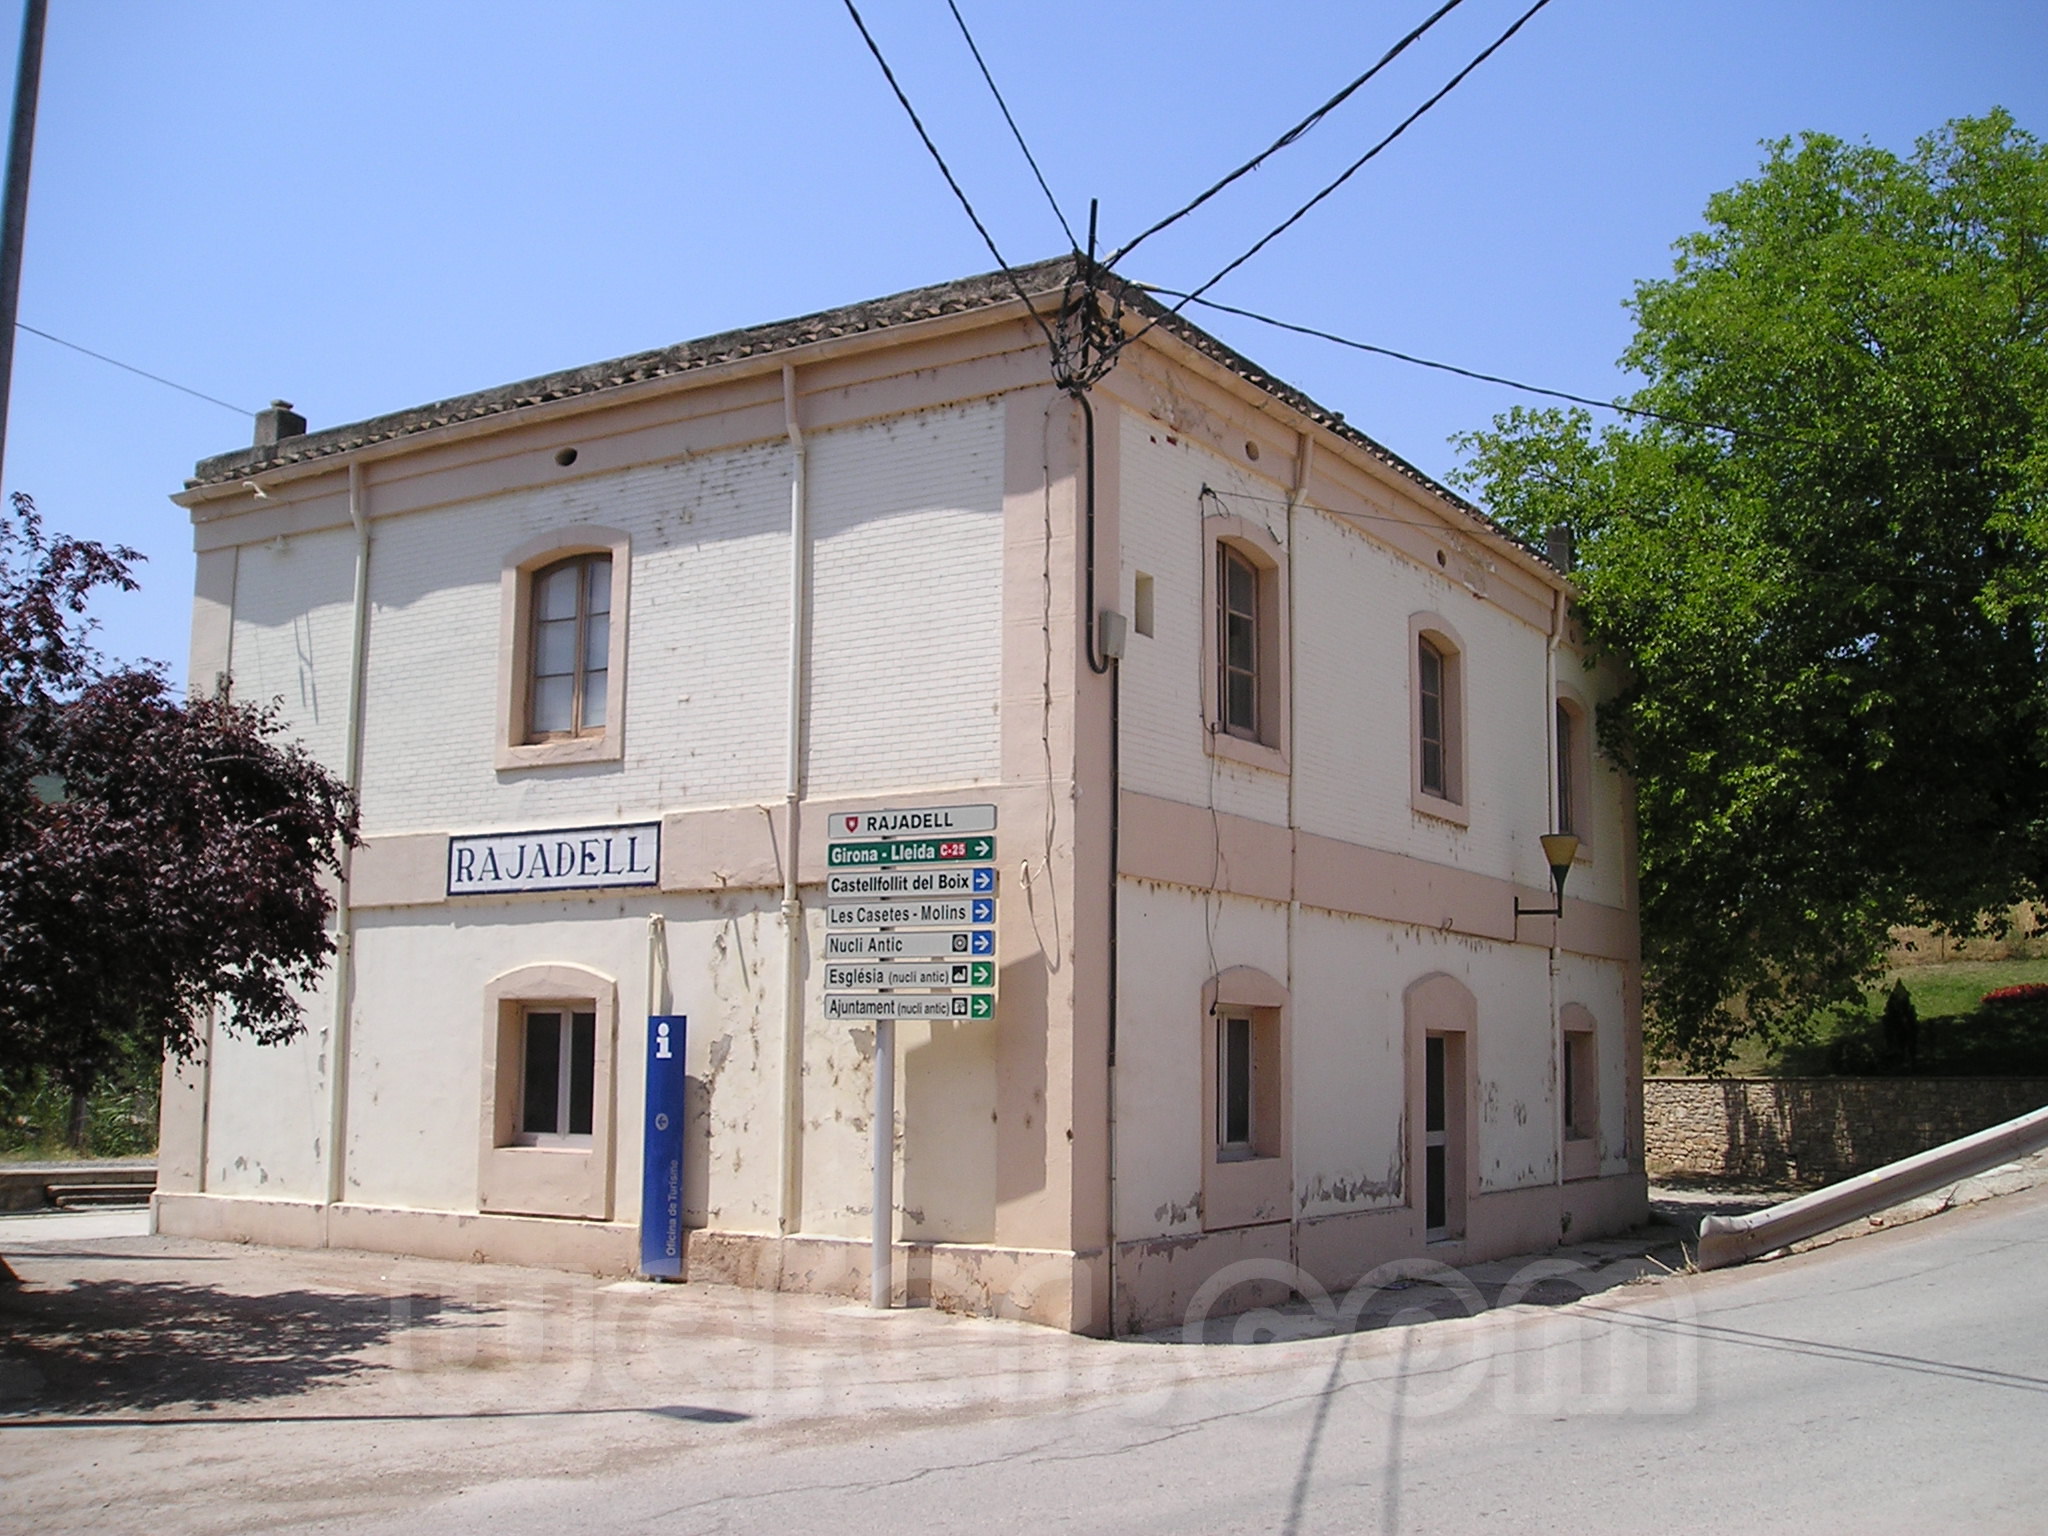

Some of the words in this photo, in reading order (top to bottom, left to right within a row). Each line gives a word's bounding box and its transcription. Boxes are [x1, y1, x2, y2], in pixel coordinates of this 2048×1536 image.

[867, 812, 953, 831] RAJADELL
[455, 835, 651, 883] RAJADELL
[831, 847, 878, 863] Girona
[891, 844, 935, 861] Lleida
[940, 843, 966, 857] C-25
[831, 876, 908, 892] Castellfollit
[912, 874, 933, 890] del
[938, 873, 969, 889] Boix
[830, 908, 853, 923] Les
[857, 906, 909, 922] Casetes
[921, 905, 966, 920] Molins
[829, 937, 863, 953] Nucli
[867, 936, 903, 952] Antic
[829, 967, 883, 987] Església
[888, 970, 917, 986] (nucli
[919, 969, 949, 985] antic)
[829, 997, 895, 1018] Ajuntament
[897, 1000, 923, 1016] (nucli
[923, 1000, 951, 1016] antic)
[667, 1202, 677, 1216] de
[666, 1219, 677, 1257] Oficina
